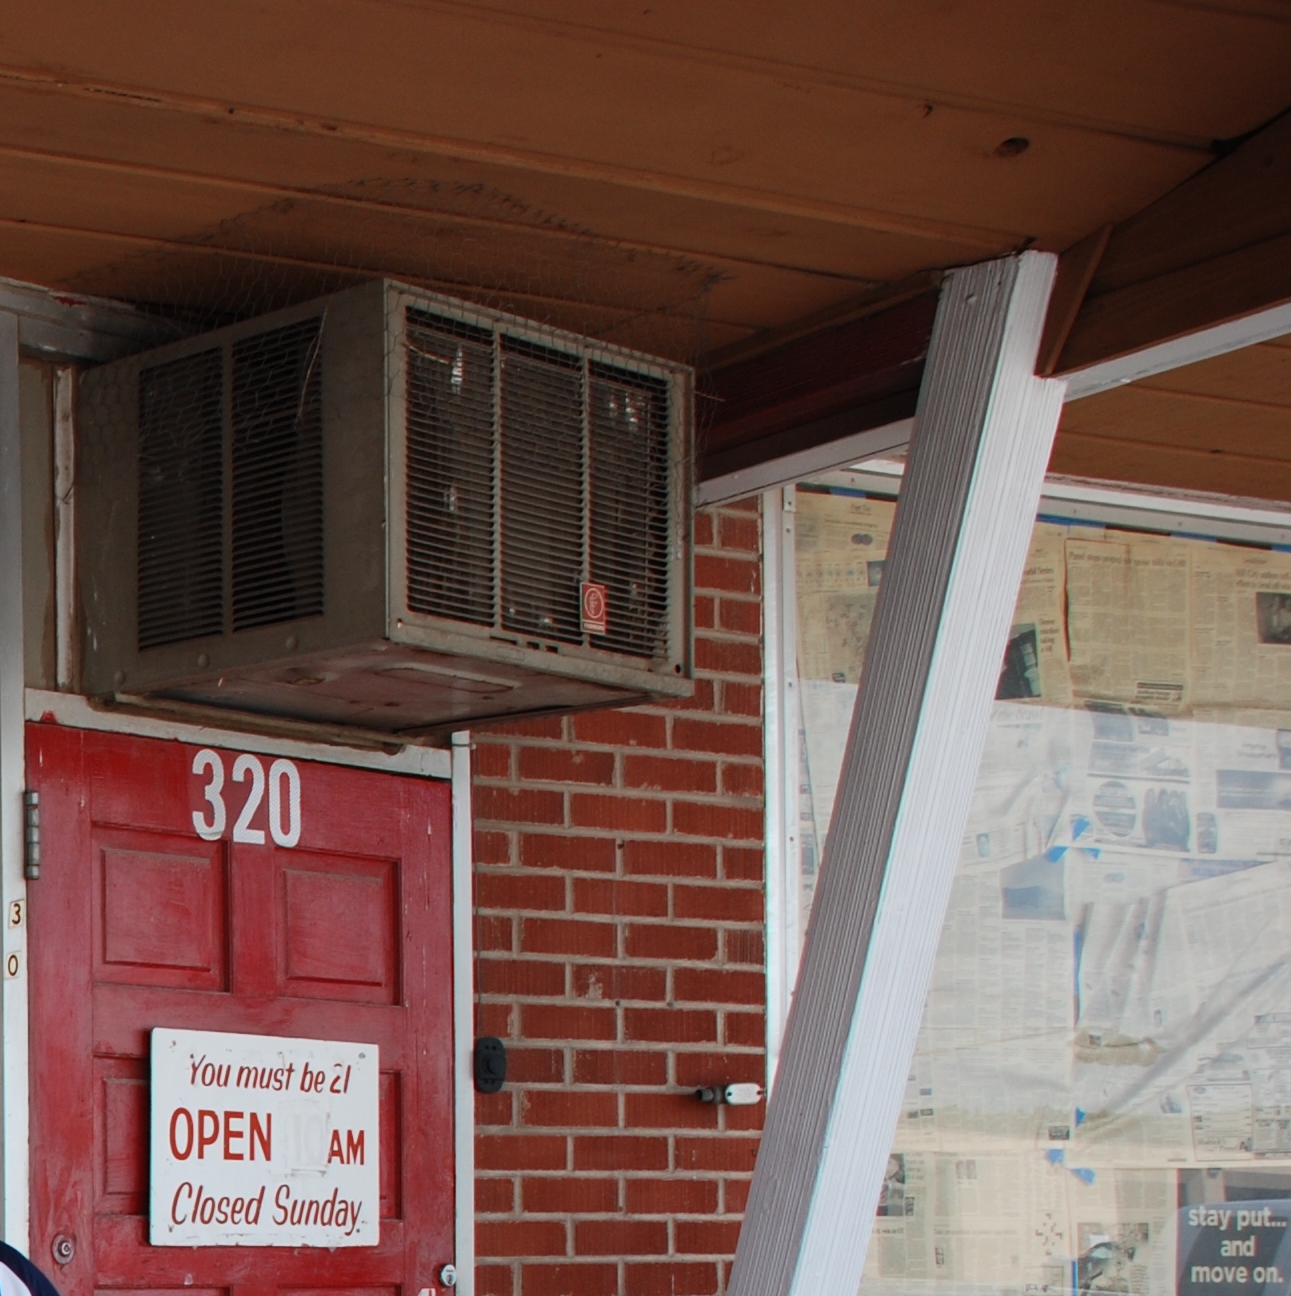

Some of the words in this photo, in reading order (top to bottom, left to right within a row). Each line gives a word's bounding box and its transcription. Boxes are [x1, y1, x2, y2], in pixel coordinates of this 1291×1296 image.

[192, 748, 302, 848] 320
[11, 902, 21, 925] 3
[189, 1053, 232, 1090] You
[236, 1063, 297, 1092] must
[300, 1061, 326, 1094] be
[328, 1062, 350, 1094] 21
[169, 1107, 272, 1162] OPEN
[327, 1129, 365, 1166] AM
[171, 1182, 265, 1226] Closed
[1188, 1205, 1231, 1231] stay
[1220, 1234, 1256, 1257] and
[1190, 1265, 1248, 1284] move
[1252, 1265, 1284, 1284] on.
